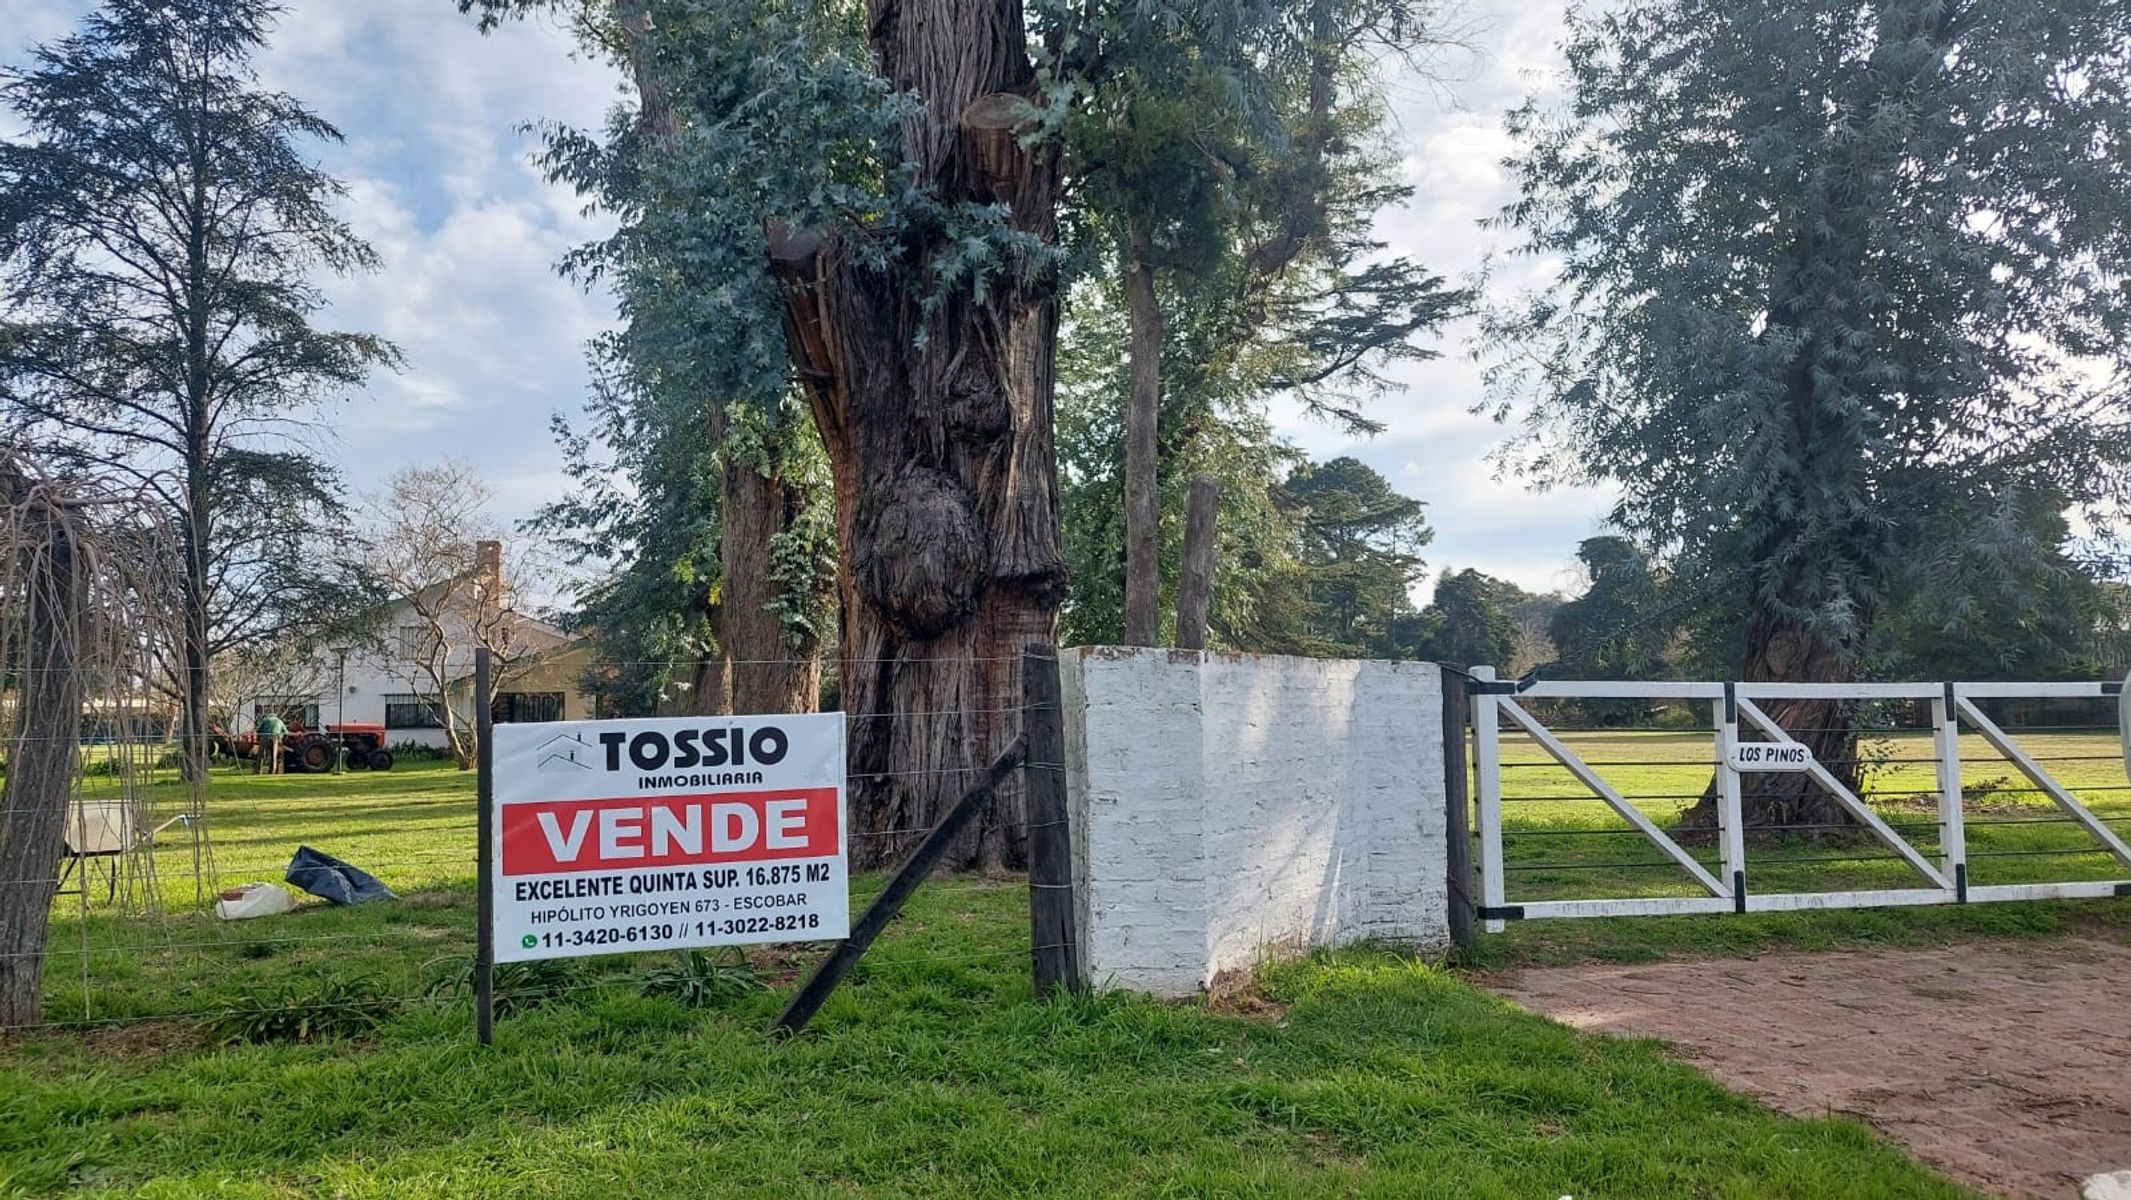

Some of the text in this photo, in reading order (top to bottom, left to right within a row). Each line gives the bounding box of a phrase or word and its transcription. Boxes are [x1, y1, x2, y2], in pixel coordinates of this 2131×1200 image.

[600, 726, 788, 771] TOSSIO
[1740, 747, 1804, 762] LOS PINOS
[639, 772, 763, 789] INMOBILIARIA
[536, 799, 809, 862] VENDE
[515, 863, 830, 901] EXCELENTE QUINTA SUP. 16.875 M2
[531, 906, 604, 924] HIPÓLITO
[611, 901, 690, 919] YRIGOYEN
[695, 899, 719, 913] 673
[734, 893, 807, 910] ESCOBAR
[542, 924, 673, 948] 11-3420-6130
[696, 914, 819, 936] 11-3022-8218
